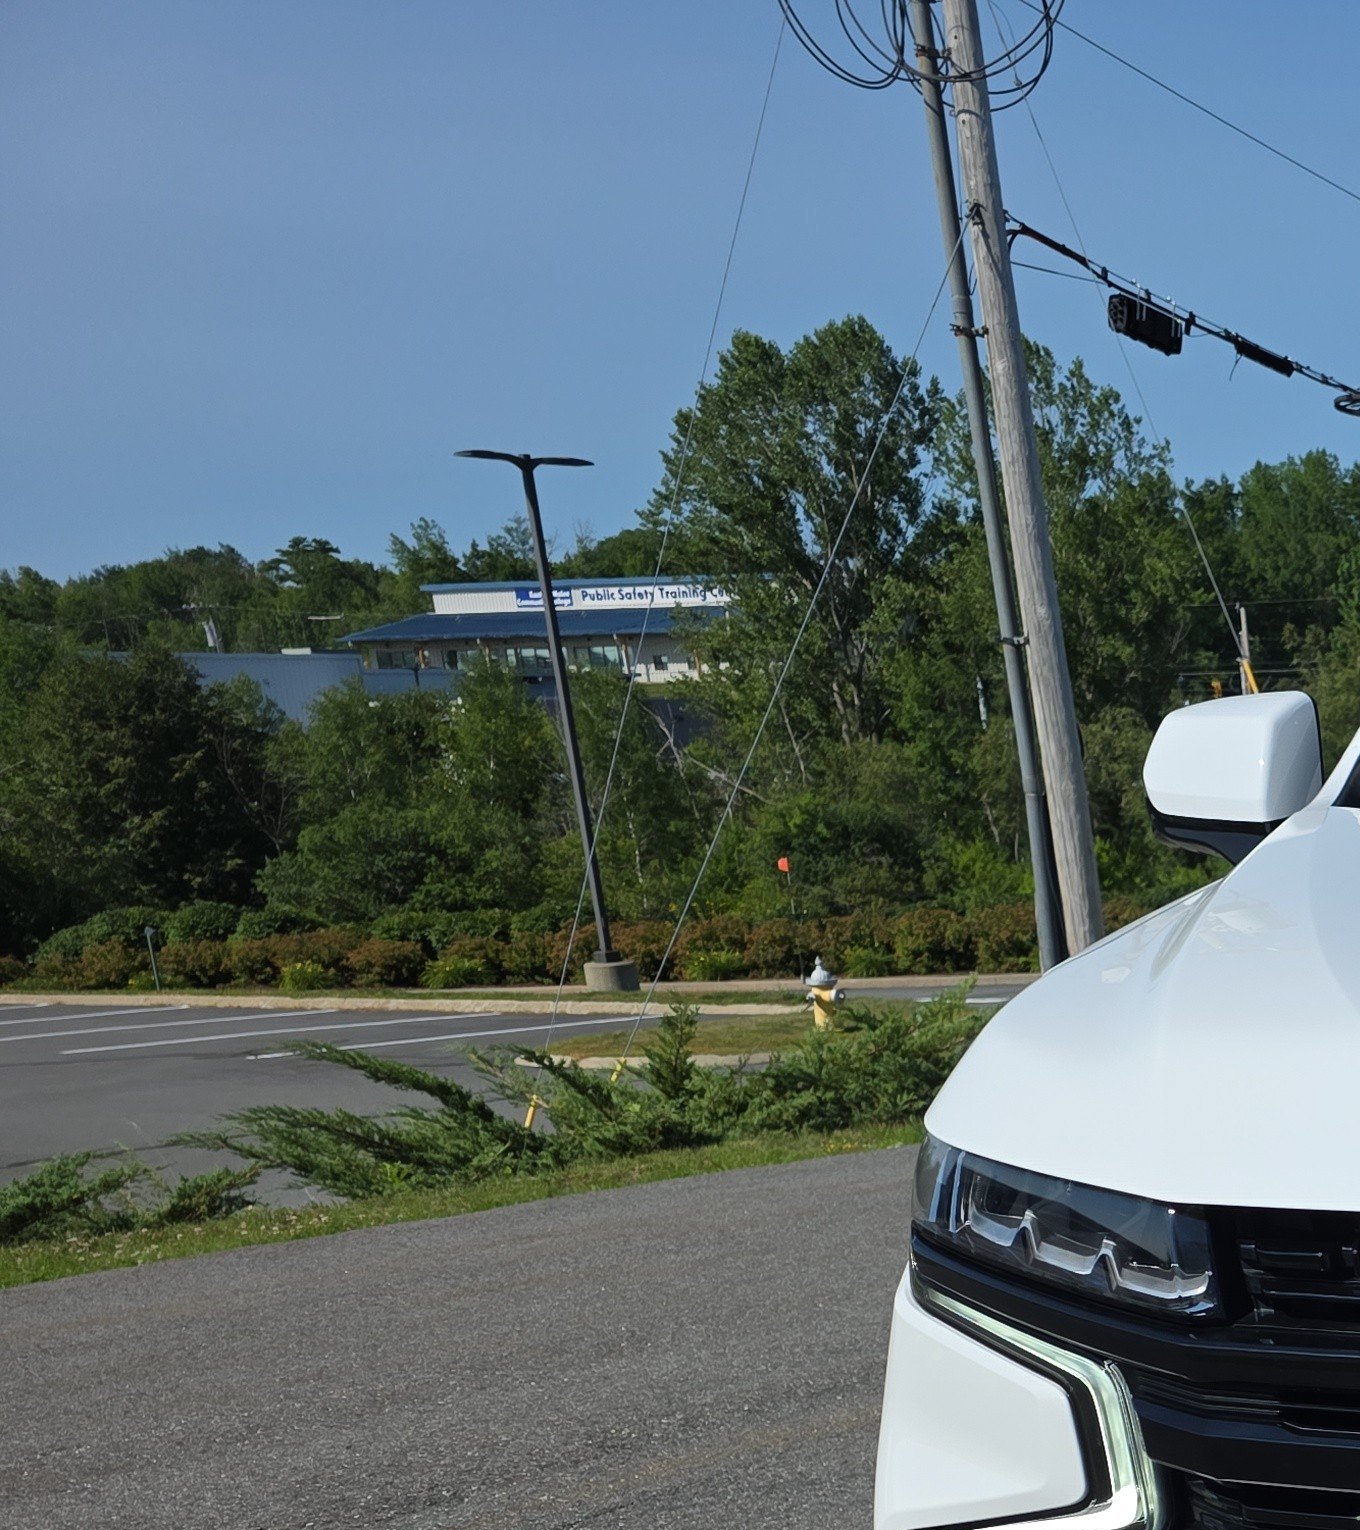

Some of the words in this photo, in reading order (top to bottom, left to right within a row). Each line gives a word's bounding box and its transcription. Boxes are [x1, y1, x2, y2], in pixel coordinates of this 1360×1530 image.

[580, 588, 615, 601] Public
[618, 586, 655, 602] Safety
[658, 586, 707, 601] Training
